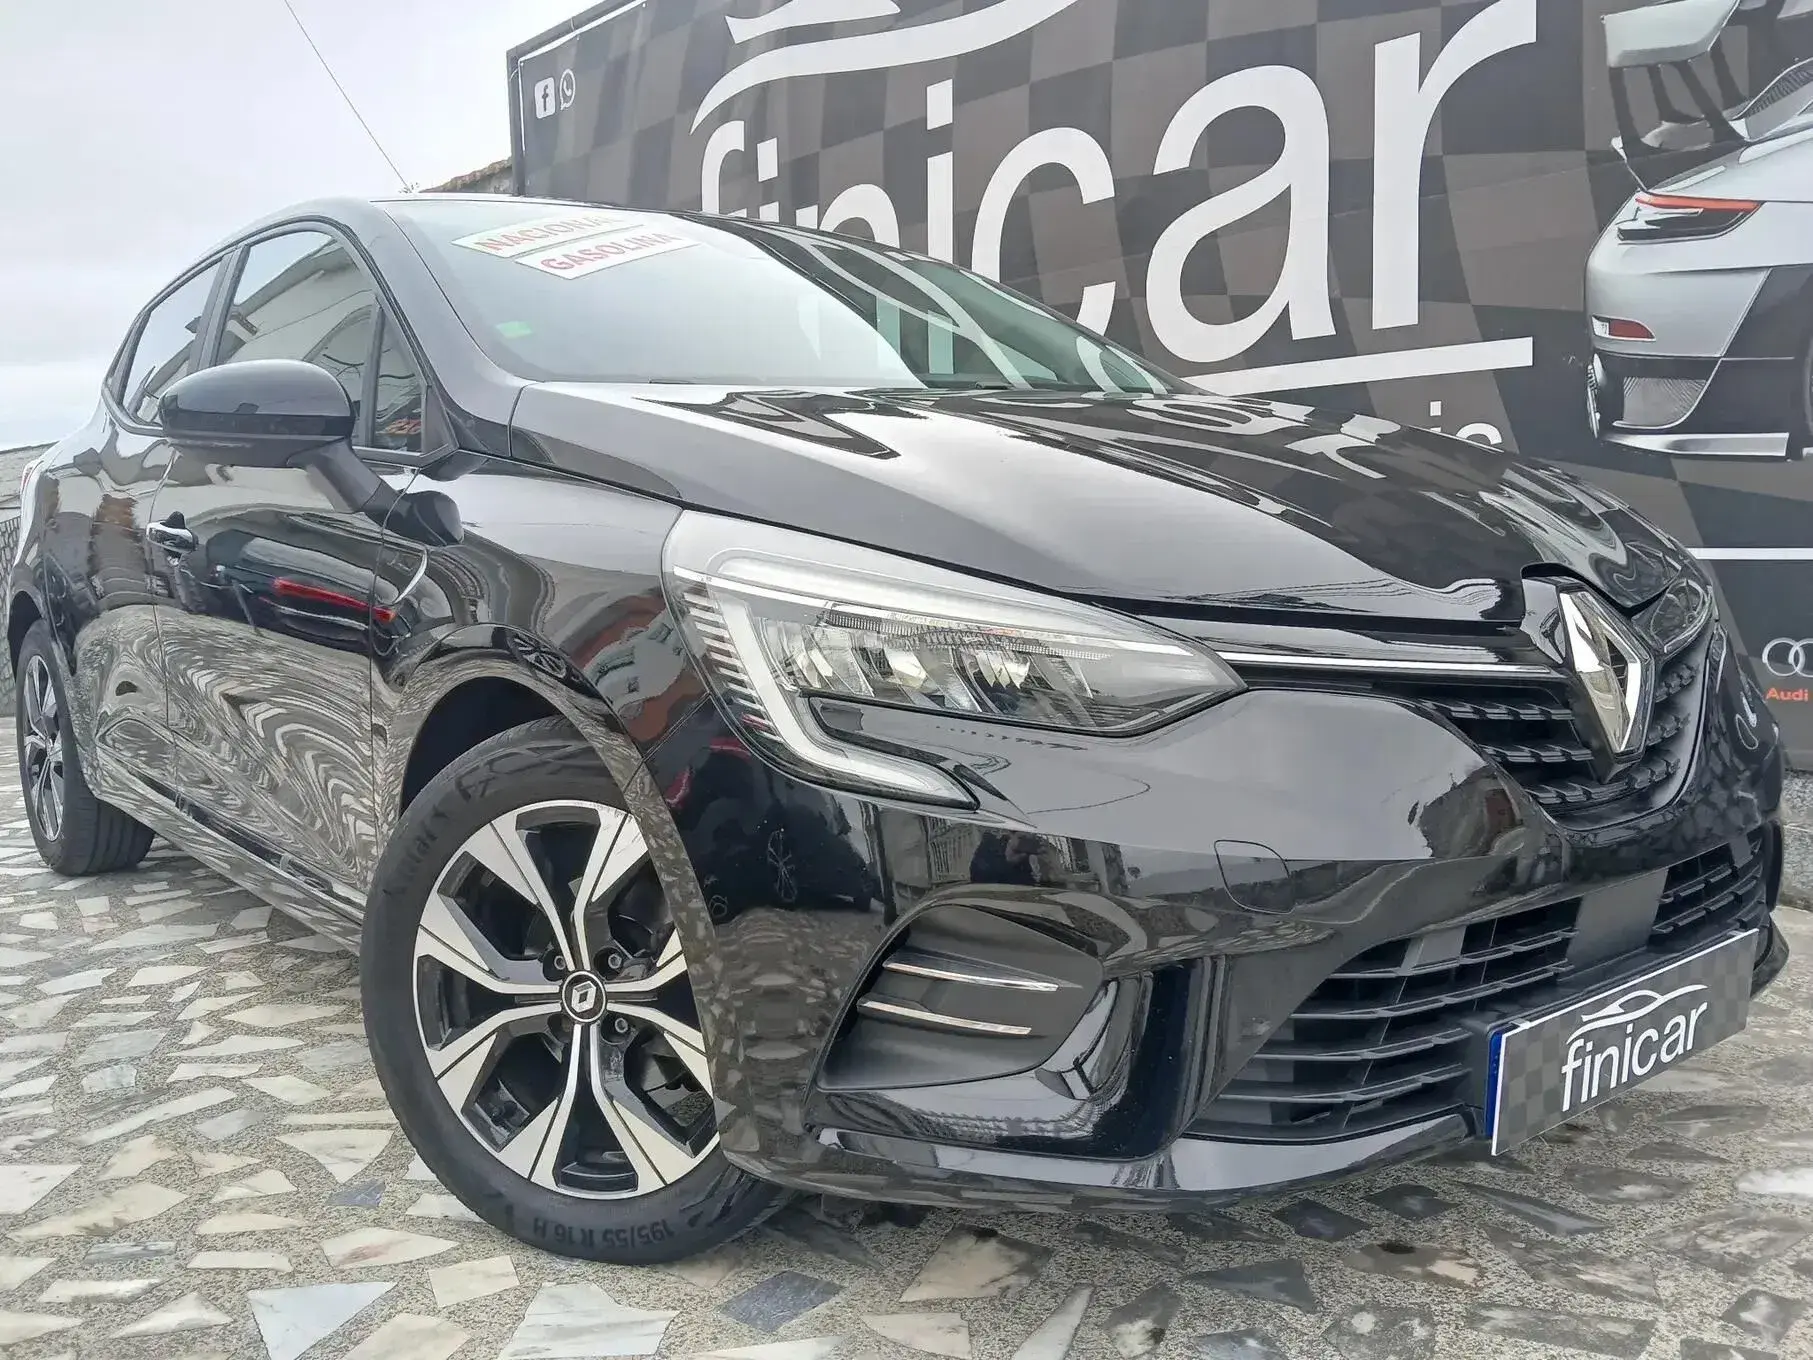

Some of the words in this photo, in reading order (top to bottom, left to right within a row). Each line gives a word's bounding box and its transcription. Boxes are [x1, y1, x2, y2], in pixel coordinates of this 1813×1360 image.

[540, 232, 683, 271] GASOLINA
[1765, 687, 1809, 702] Audi
[1561, 1002, 1708, 1113] finicar
